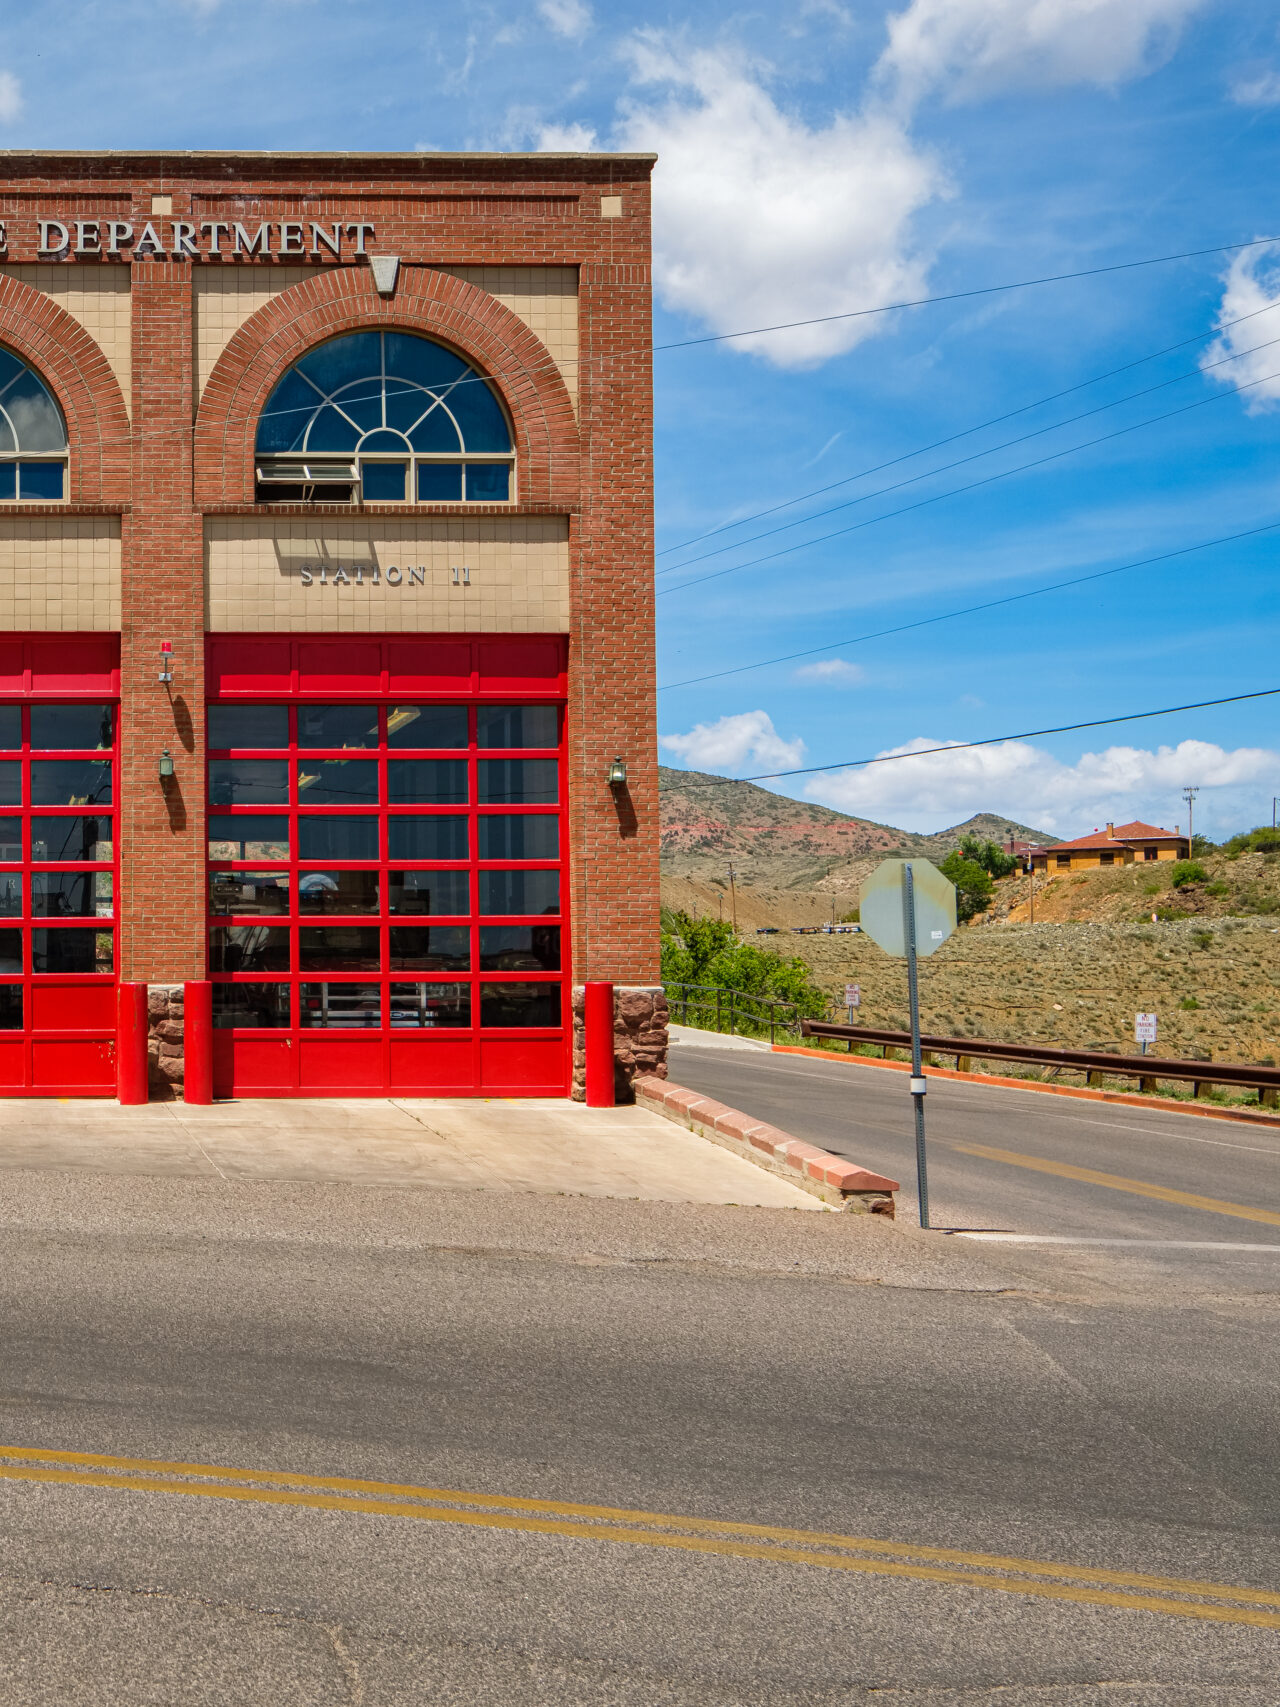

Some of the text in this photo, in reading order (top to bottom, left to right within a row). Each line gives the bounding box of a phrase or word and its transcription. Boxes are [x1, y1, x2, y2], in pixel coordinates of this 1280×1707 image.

[37, 220, 375, 255] DEPARTMENT
[300, 565, 472, 585] STATION 11
